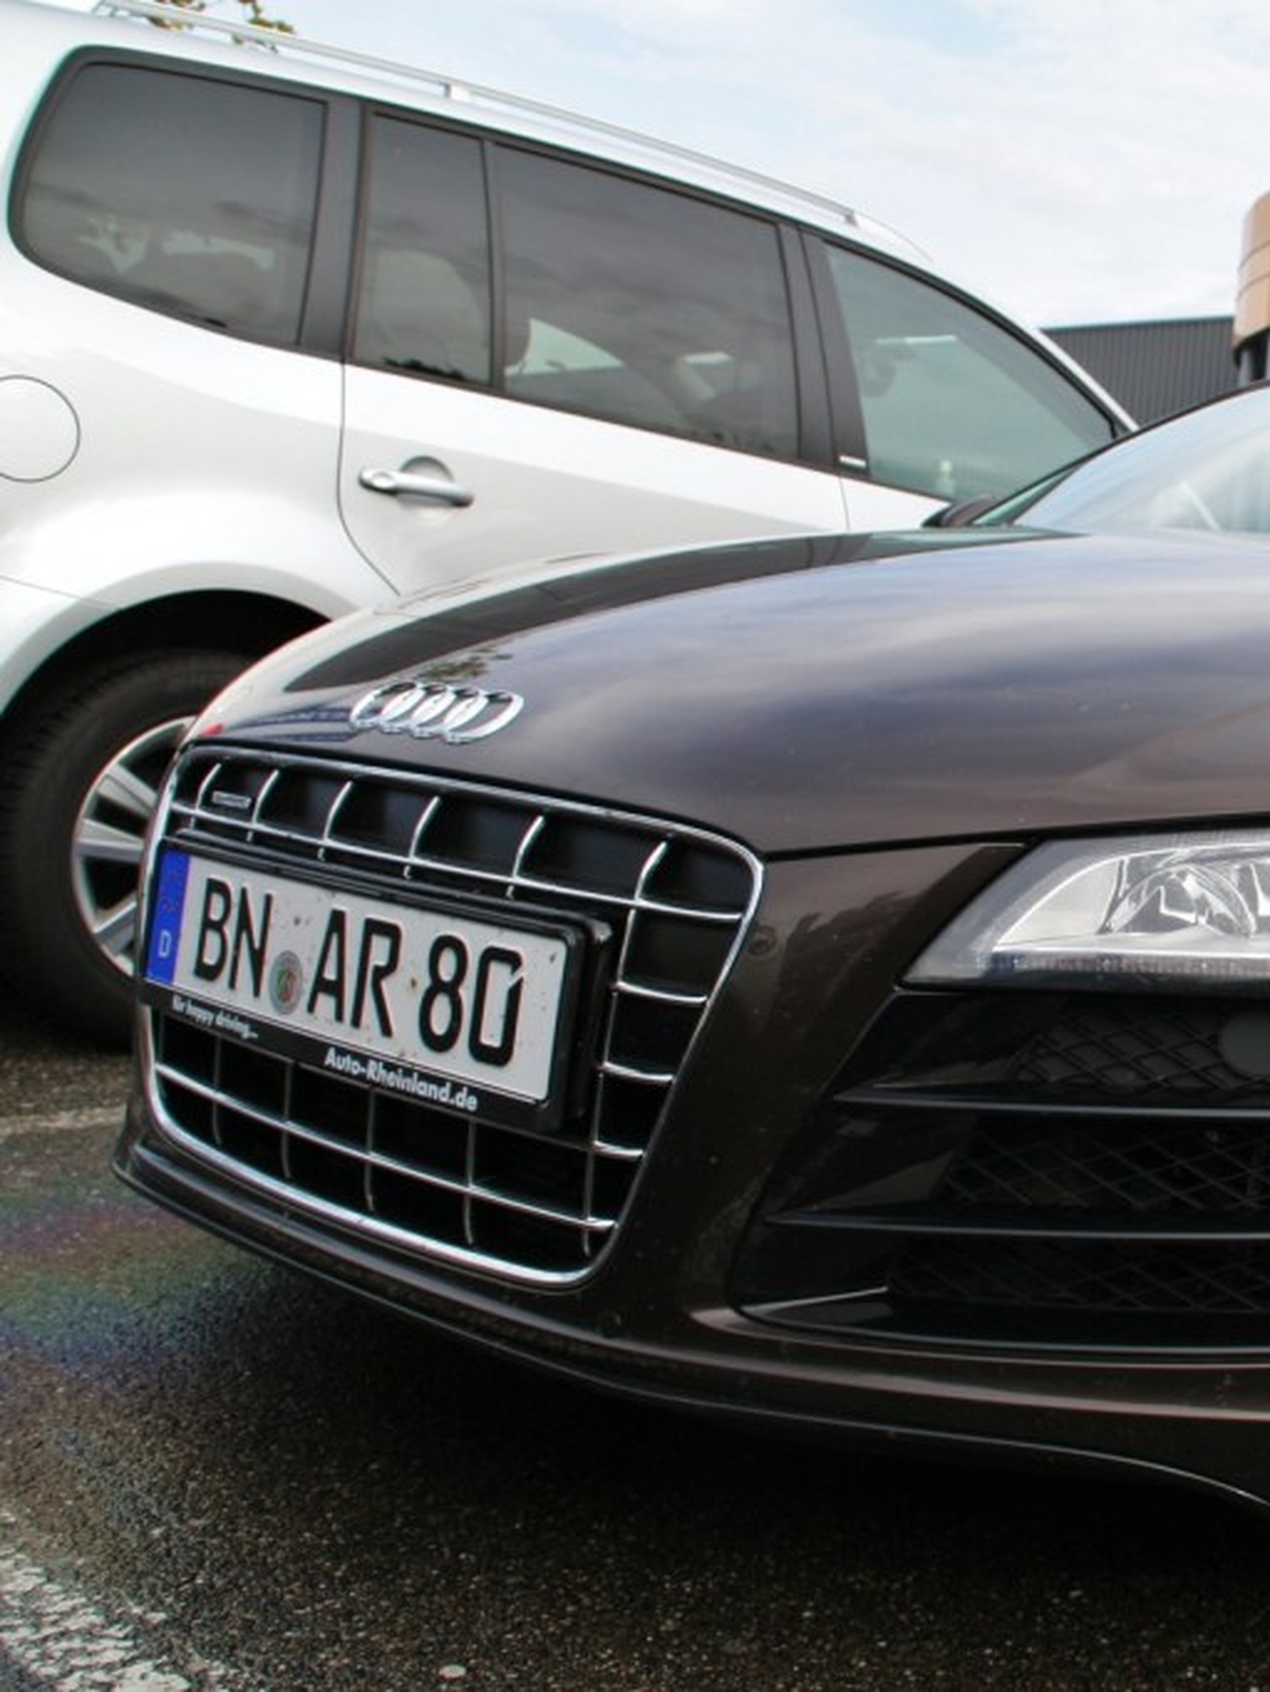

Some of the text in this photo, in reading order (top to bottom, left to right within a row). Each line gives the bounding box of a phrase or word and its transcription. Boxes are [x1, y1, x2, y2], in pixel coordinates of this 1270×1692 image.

[193, 876, 524, 1068] BN AR 80
[324, 1047, 478, 1113] Auto-Rheinland.de
